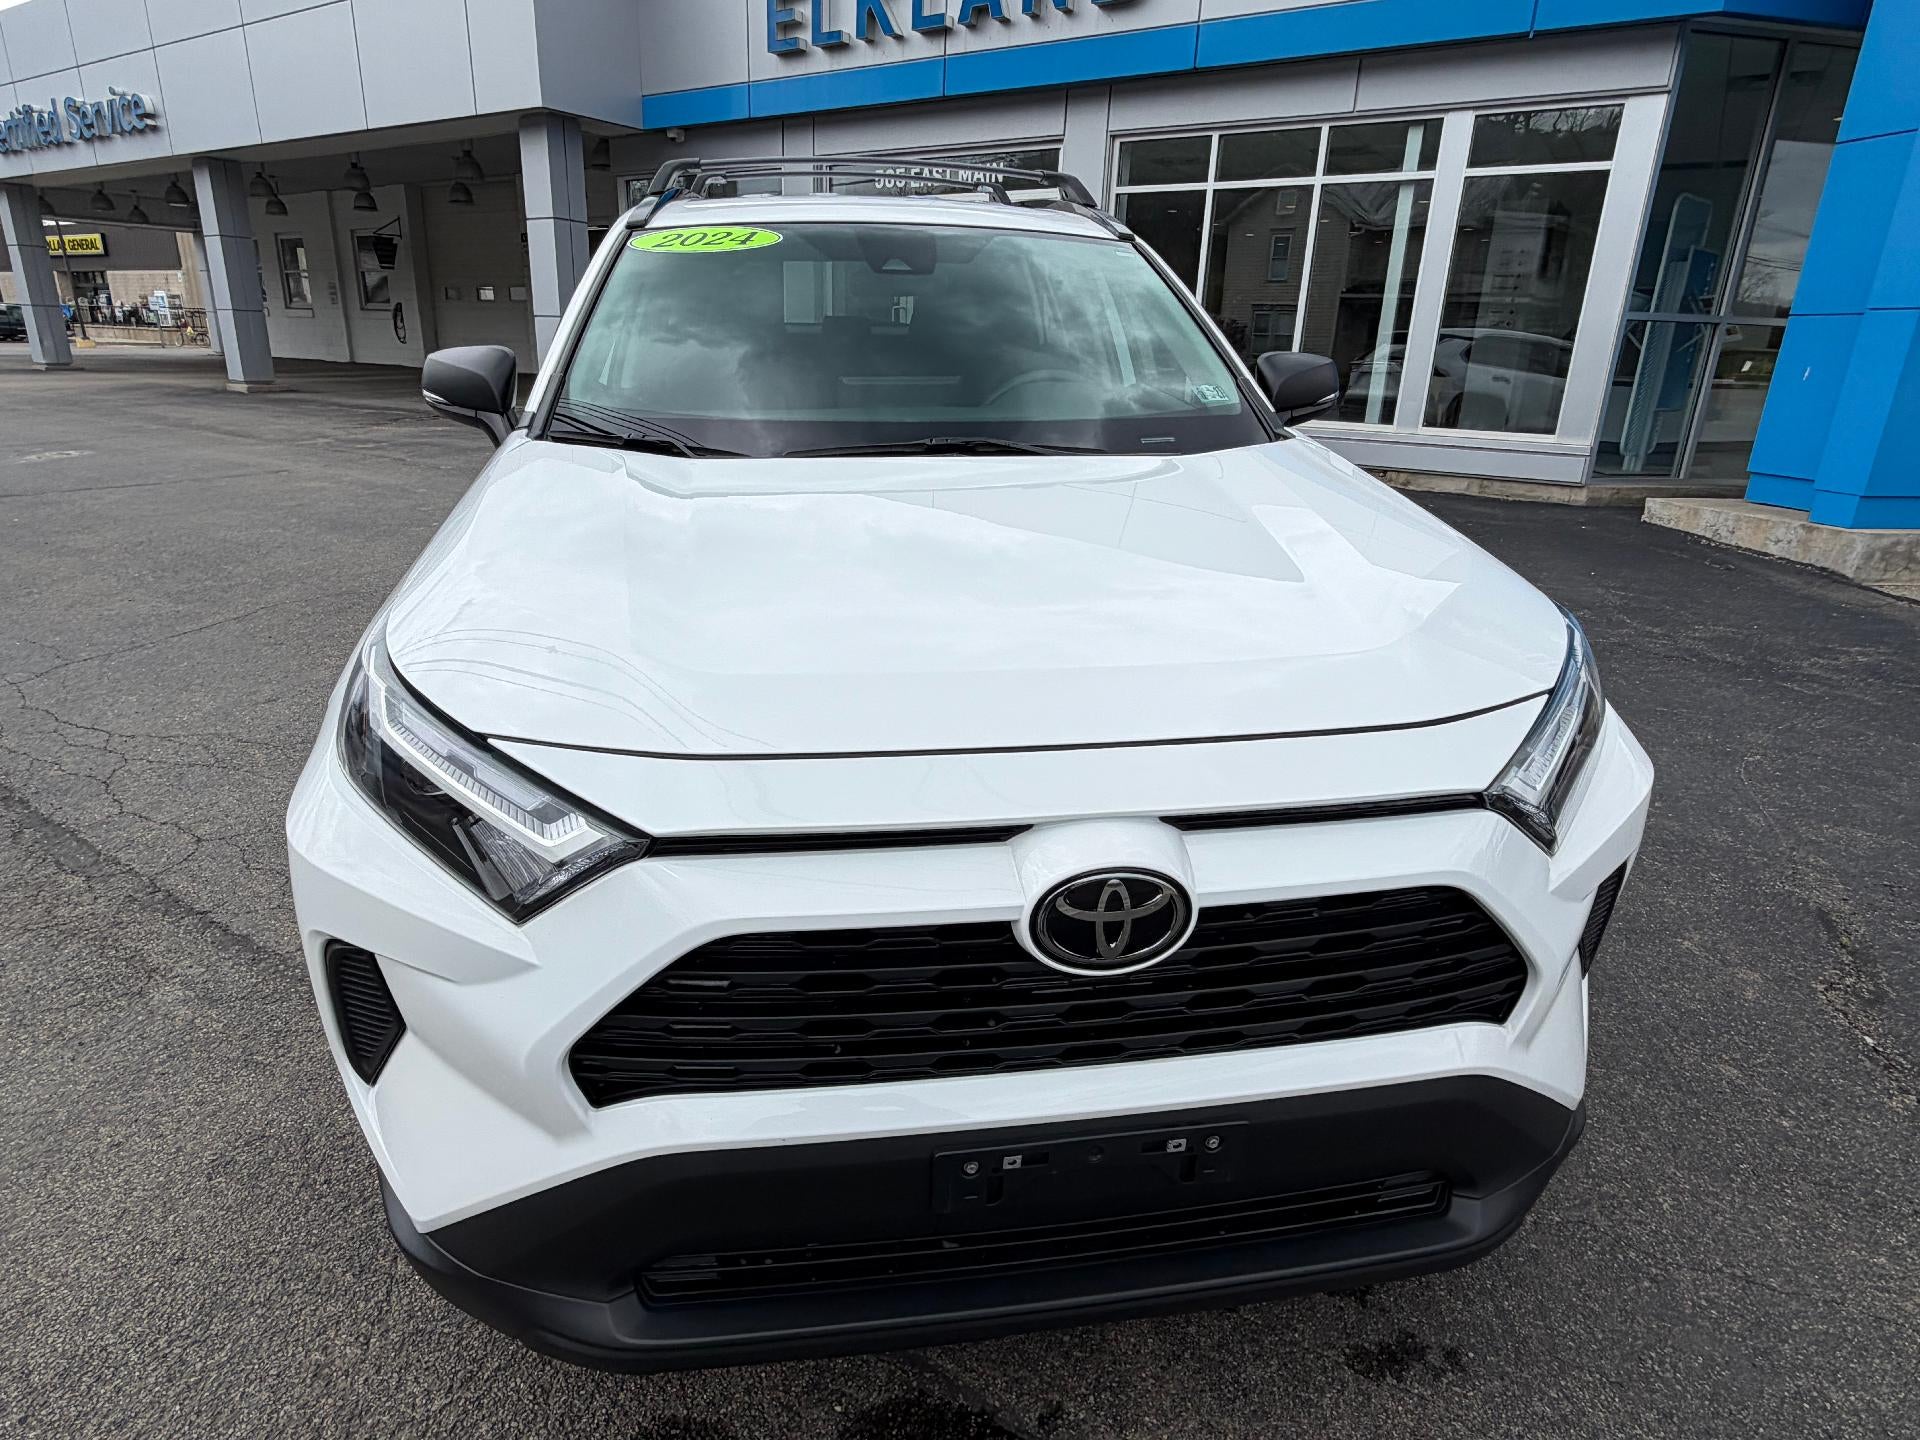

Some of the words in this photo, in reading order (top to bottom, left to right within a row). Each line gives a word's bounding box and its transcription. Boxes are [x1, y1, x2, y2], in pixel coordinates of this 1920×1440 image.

[767, 0, 1122, 54] ELKL
[64, 86, 148, 139] Service
[910, 166, 952, 188] EAST
[958, 161, 1004, 184] MAIN
[67, 238, 100, 251] GENERAL
[652, 231, 758, 248] 2024
